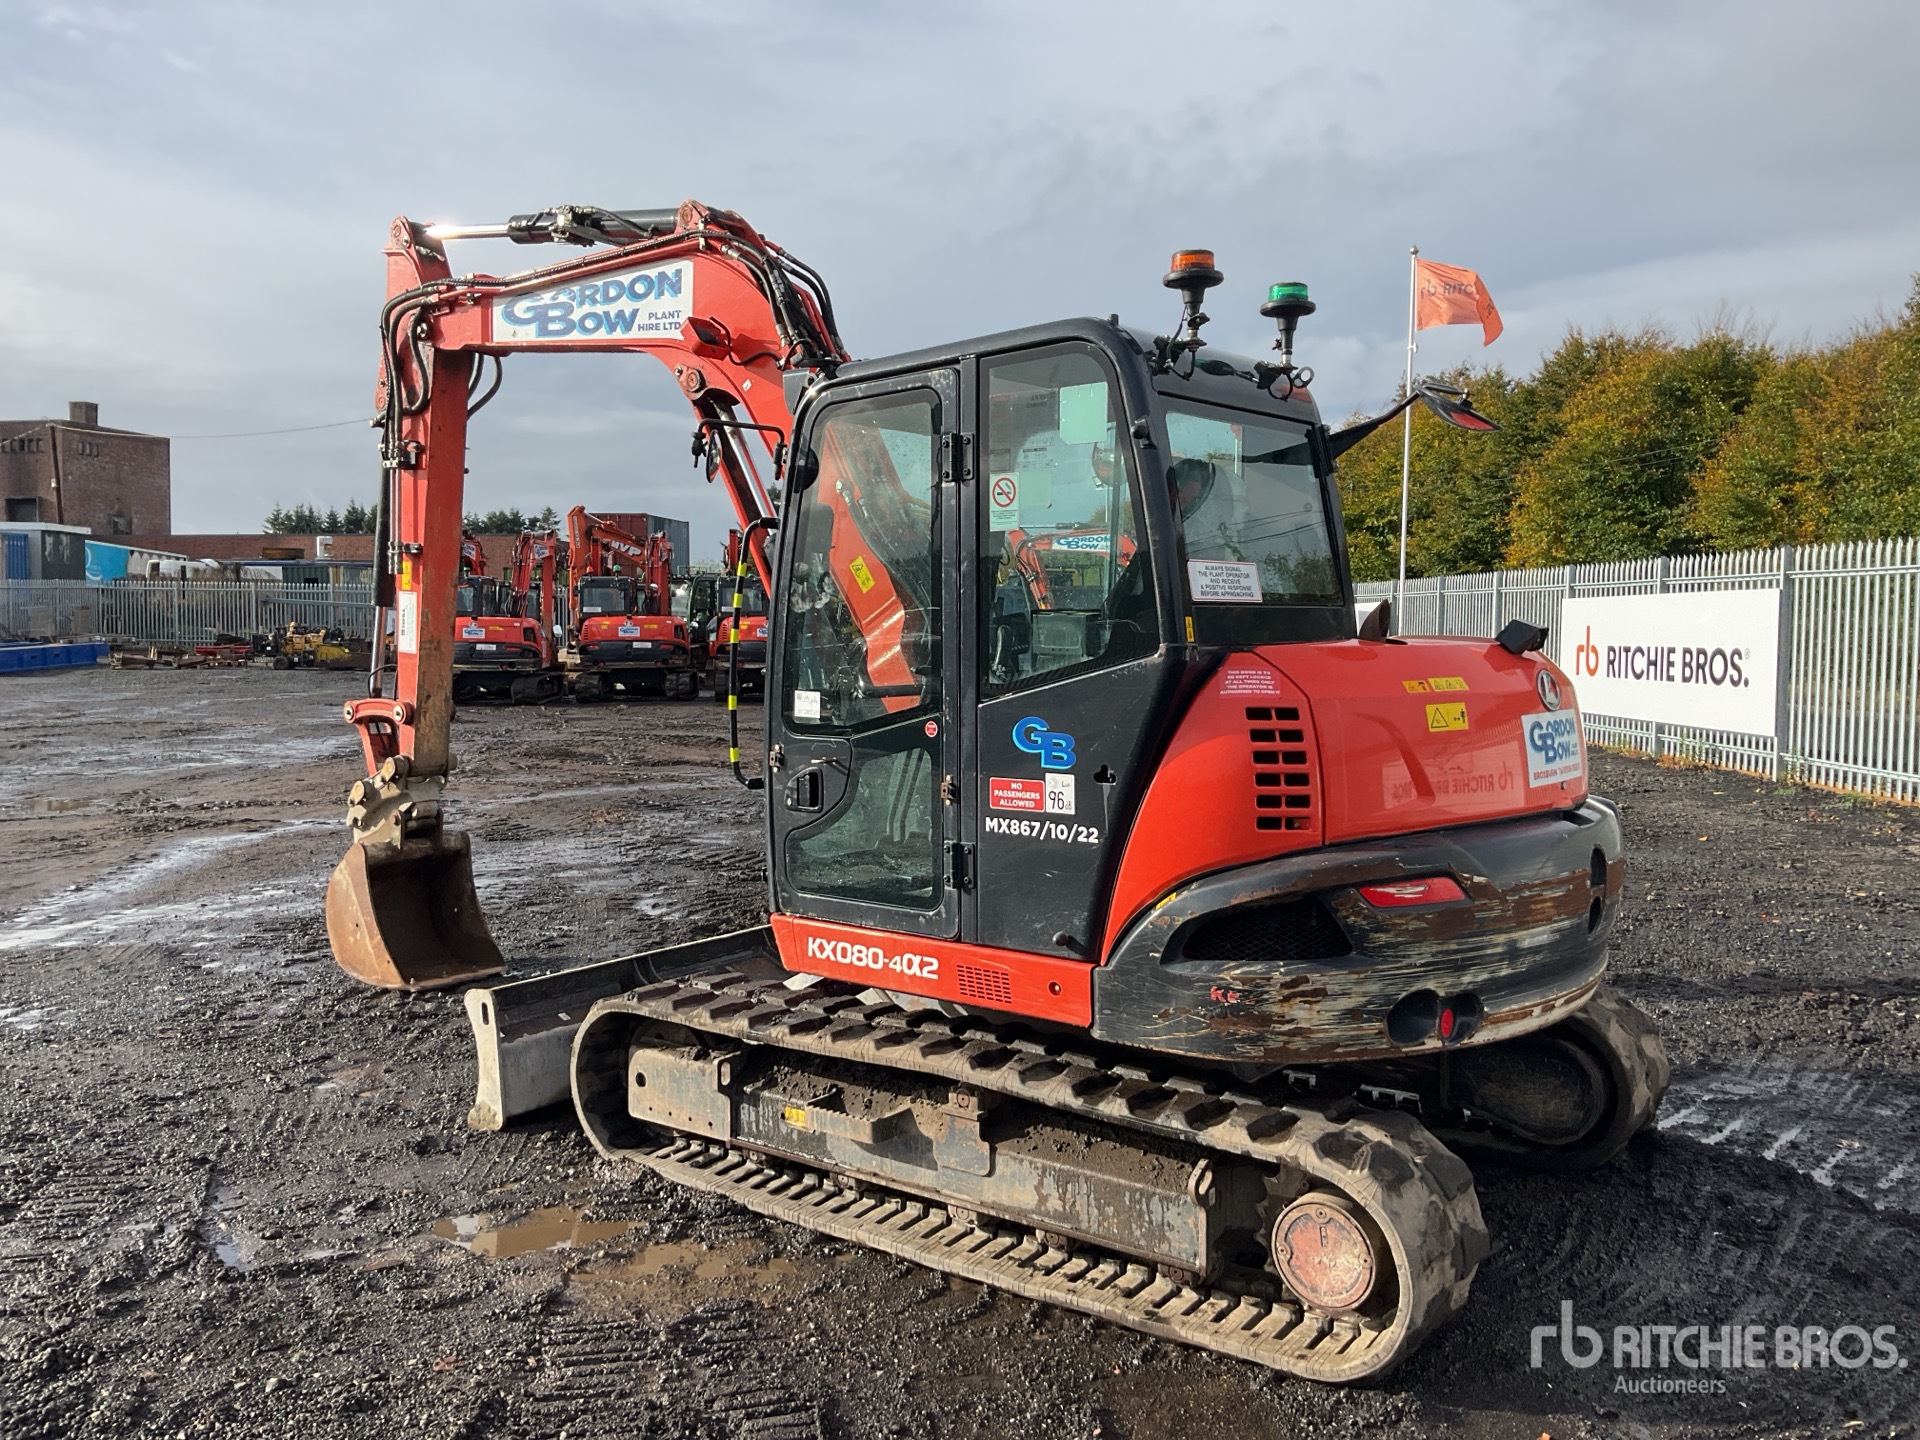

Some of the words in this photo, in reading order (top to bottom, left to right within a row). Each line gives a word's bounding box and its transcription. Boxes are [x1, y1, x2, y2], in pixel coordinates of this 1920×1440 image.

[502, 268, 682, 326] GORDON
[535, 301, 640, 338] BOW
[637, 322, 661, 331] HIRE
[663, 321, 681, 331] LTD
[648, 310, 682, 320] PLANT
[1576, 625, 1599, 677] rb
[1606, 645, 1676, 683] RITCHIE
[1681, 647, 1749, 688] BROS.
[1012, 716, 1076, 769] GB
[1529, 718, 1576, 753] GORDON
[1543, 732, 1571, 765] BOW
[994, 789, 1040, 799] PASSENGERS
[1011, 782, 1022, 790] NO
[1000, 799, 1035, 808] ALLOWED
[1048, 790, 1064, 810] 96
[985, 816, 1099, 843] MX867/10/22
